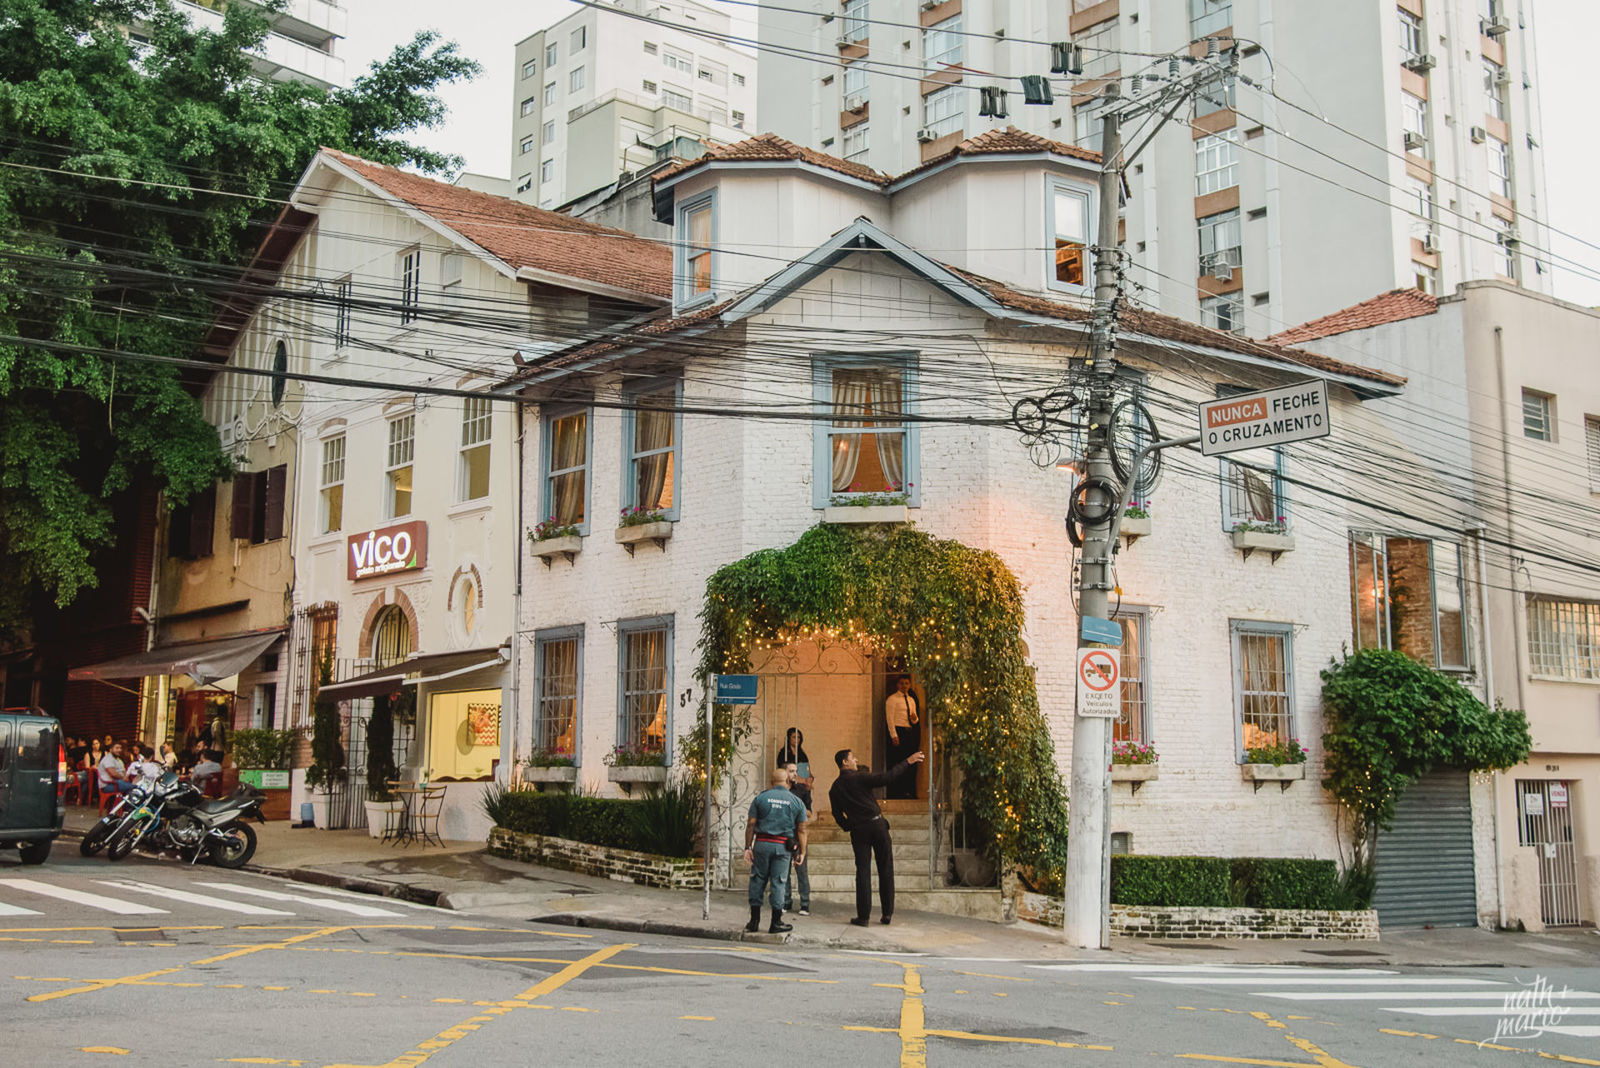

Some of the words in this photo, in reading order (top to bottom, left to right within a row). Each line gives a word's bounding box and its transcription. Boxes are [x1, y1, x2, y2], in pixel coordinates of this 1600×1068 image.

[1211, 402, 1262, 425] NUNCA
[1273, 391, 1320, 413] FECHE
[1209, 432, 1218, 445] O
[1223, 413, 1322, 442] CRUZAMENTO
[680, 688, 692, 708] 57
[1081, 707, 1118, 715] Autorizados
